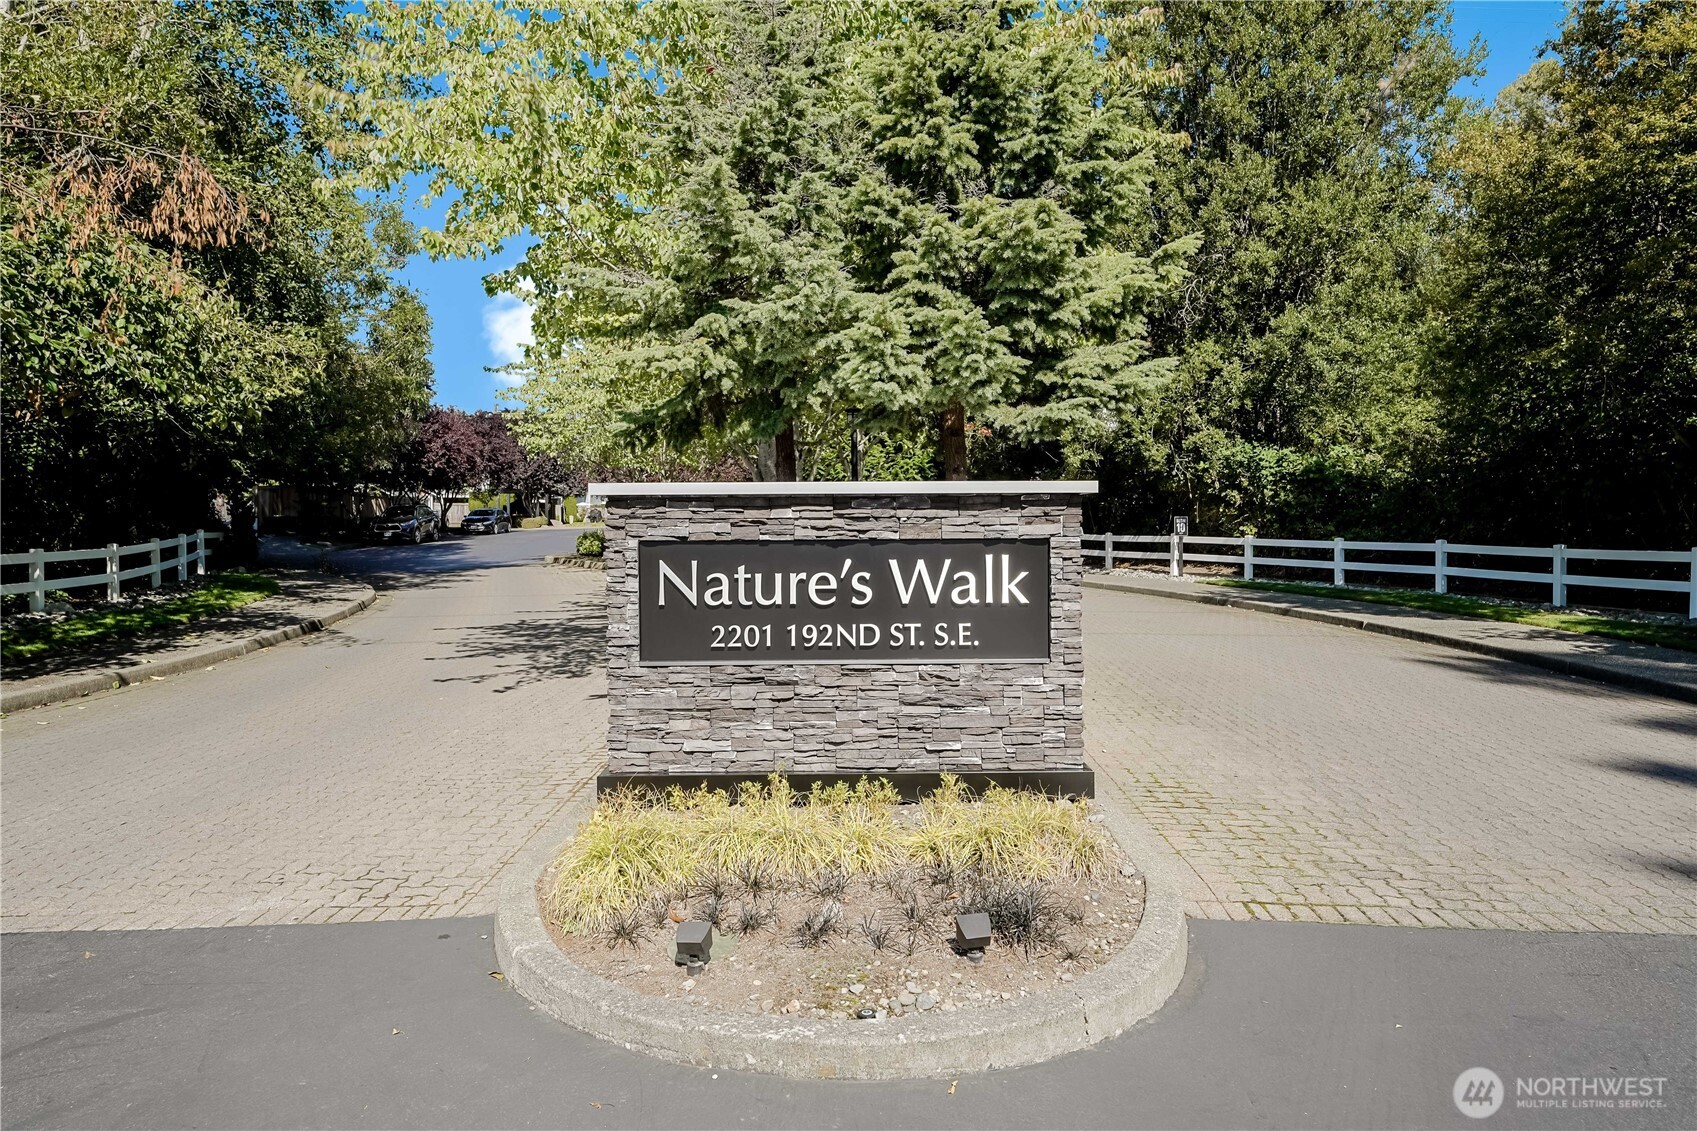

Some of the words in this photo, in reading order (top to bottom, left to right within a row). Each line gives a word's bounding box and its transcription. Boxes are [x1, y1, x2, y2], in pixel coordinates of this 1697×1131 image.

[658, 558, 873, 607] Nature's
[888, 553, 1031, 606] Walk
[710, 623, 772, 648] 2201
[786, 623, 881, 647] 192ND
[889, 622, 925, 647] ST.
[934, 622, 980, 647] S.E.
